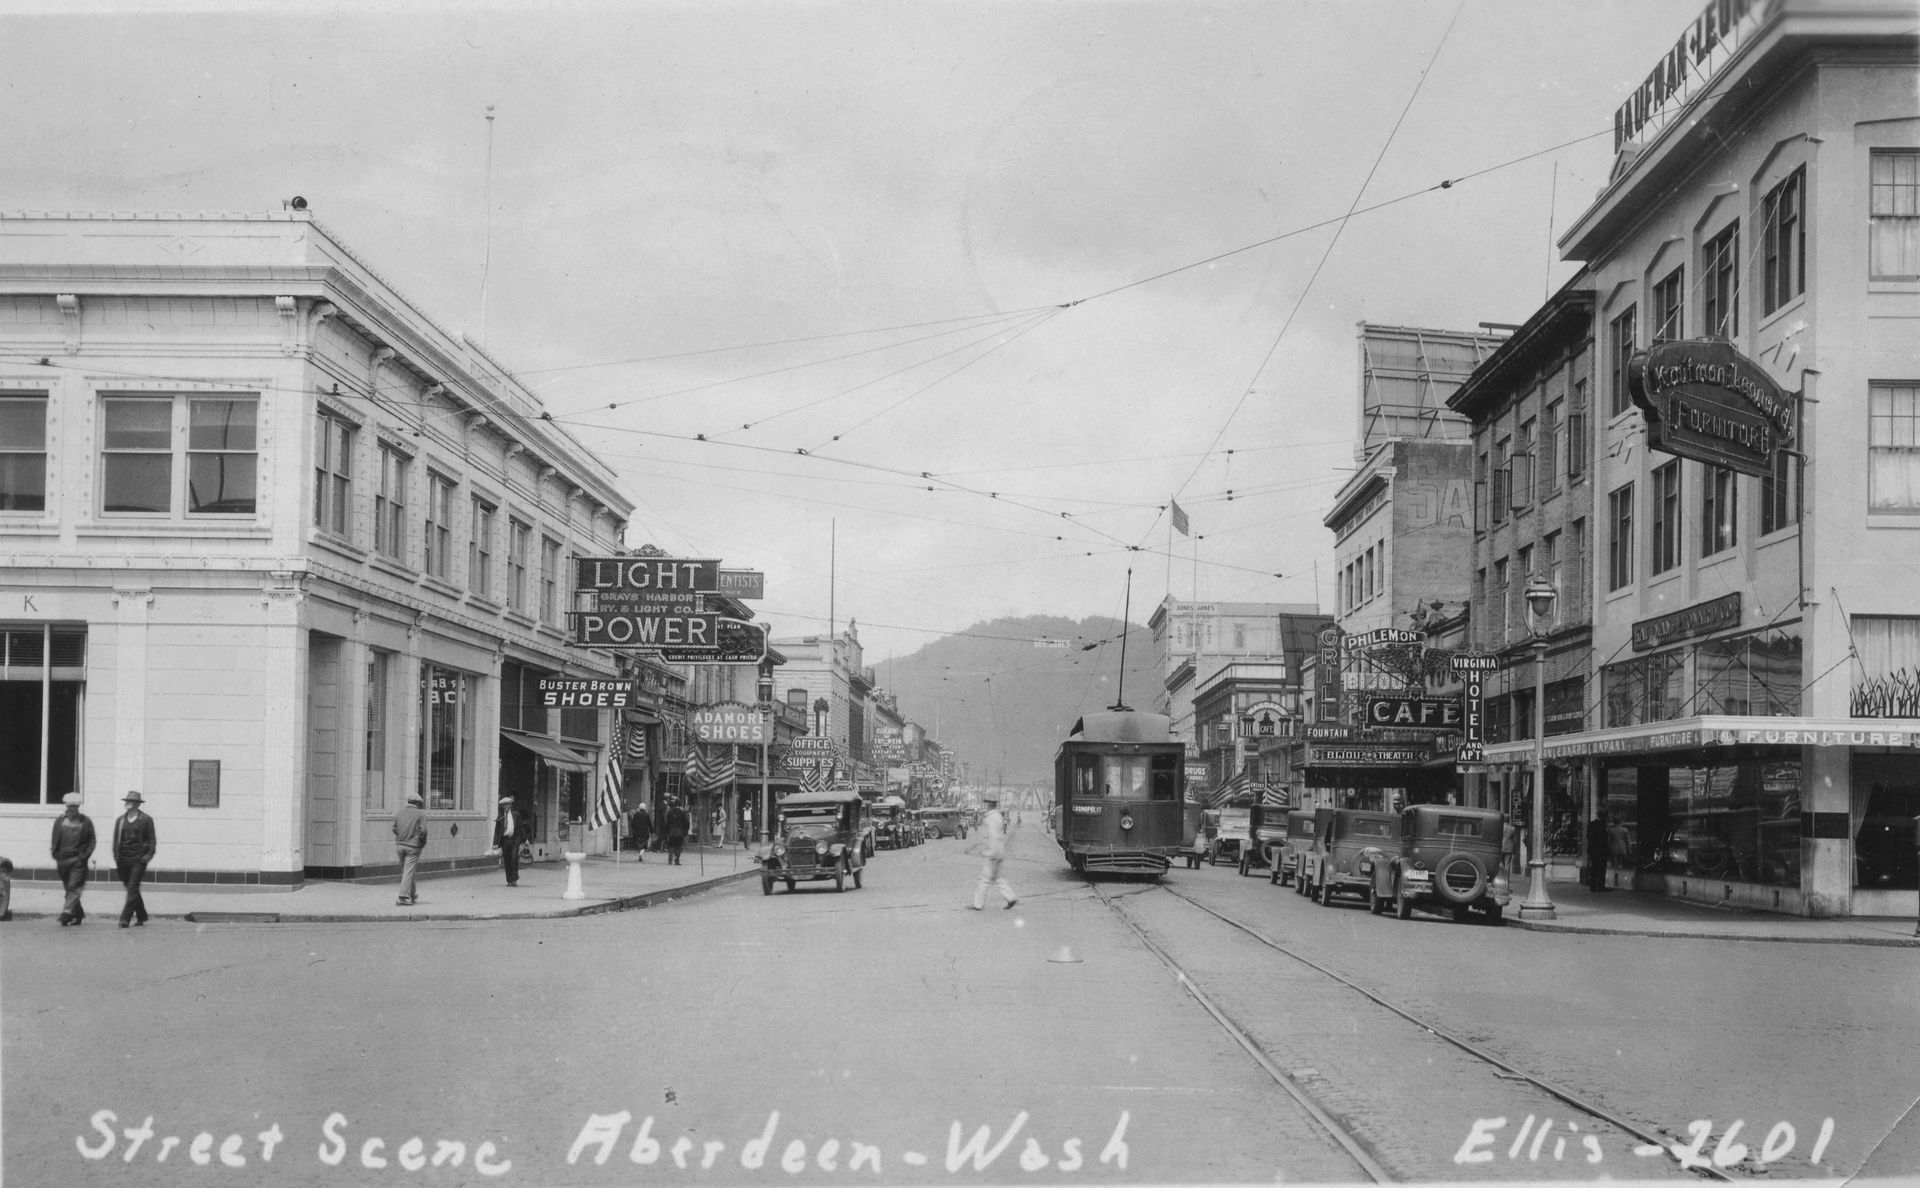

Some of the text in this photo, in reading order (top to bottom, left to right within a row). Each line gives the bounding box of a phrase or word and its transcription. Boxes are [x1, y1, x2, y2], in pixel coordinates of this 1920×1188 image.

[594, 562, 703, 589] LIGHT
[720, 574, 760, 589] ENTISTS
[24, 595, 38, 612] K
[601, 593, 694, 602] GRAYS HARBOR
[601, 605, 618, 613] RY.
[634, 605, 669, 614] LIGHT
[673, 606, 695, 614] CO.
[584, 616, 707, 644] POWER
[1348, 629, 1417, 649] PHILEMON
[1453, 658, 1496, 668] VIRGINIA
[1321, 629, 1338, 721] GRILL
[539, 679, 632, 692] BUSTER BROWN
[543, 692, 627, 707] SHOES
[1469, 670, 1480, 740] HOTEL
[693, 712, 766, 724] ADAMORE
[700, 725, 763, 740] SHOES
[1307, 728, 1348, 738] FOUNTAIN
[1650, 731, 1692, 748] FURNITURE
[1746, 731, 1903, 745] FURNITURE
[794, 739, 830, 749] OFFICE
[1327, 751, 1414, 760] BIJOU THEATER
[1184, 767, 1206, 775] DRUGS
